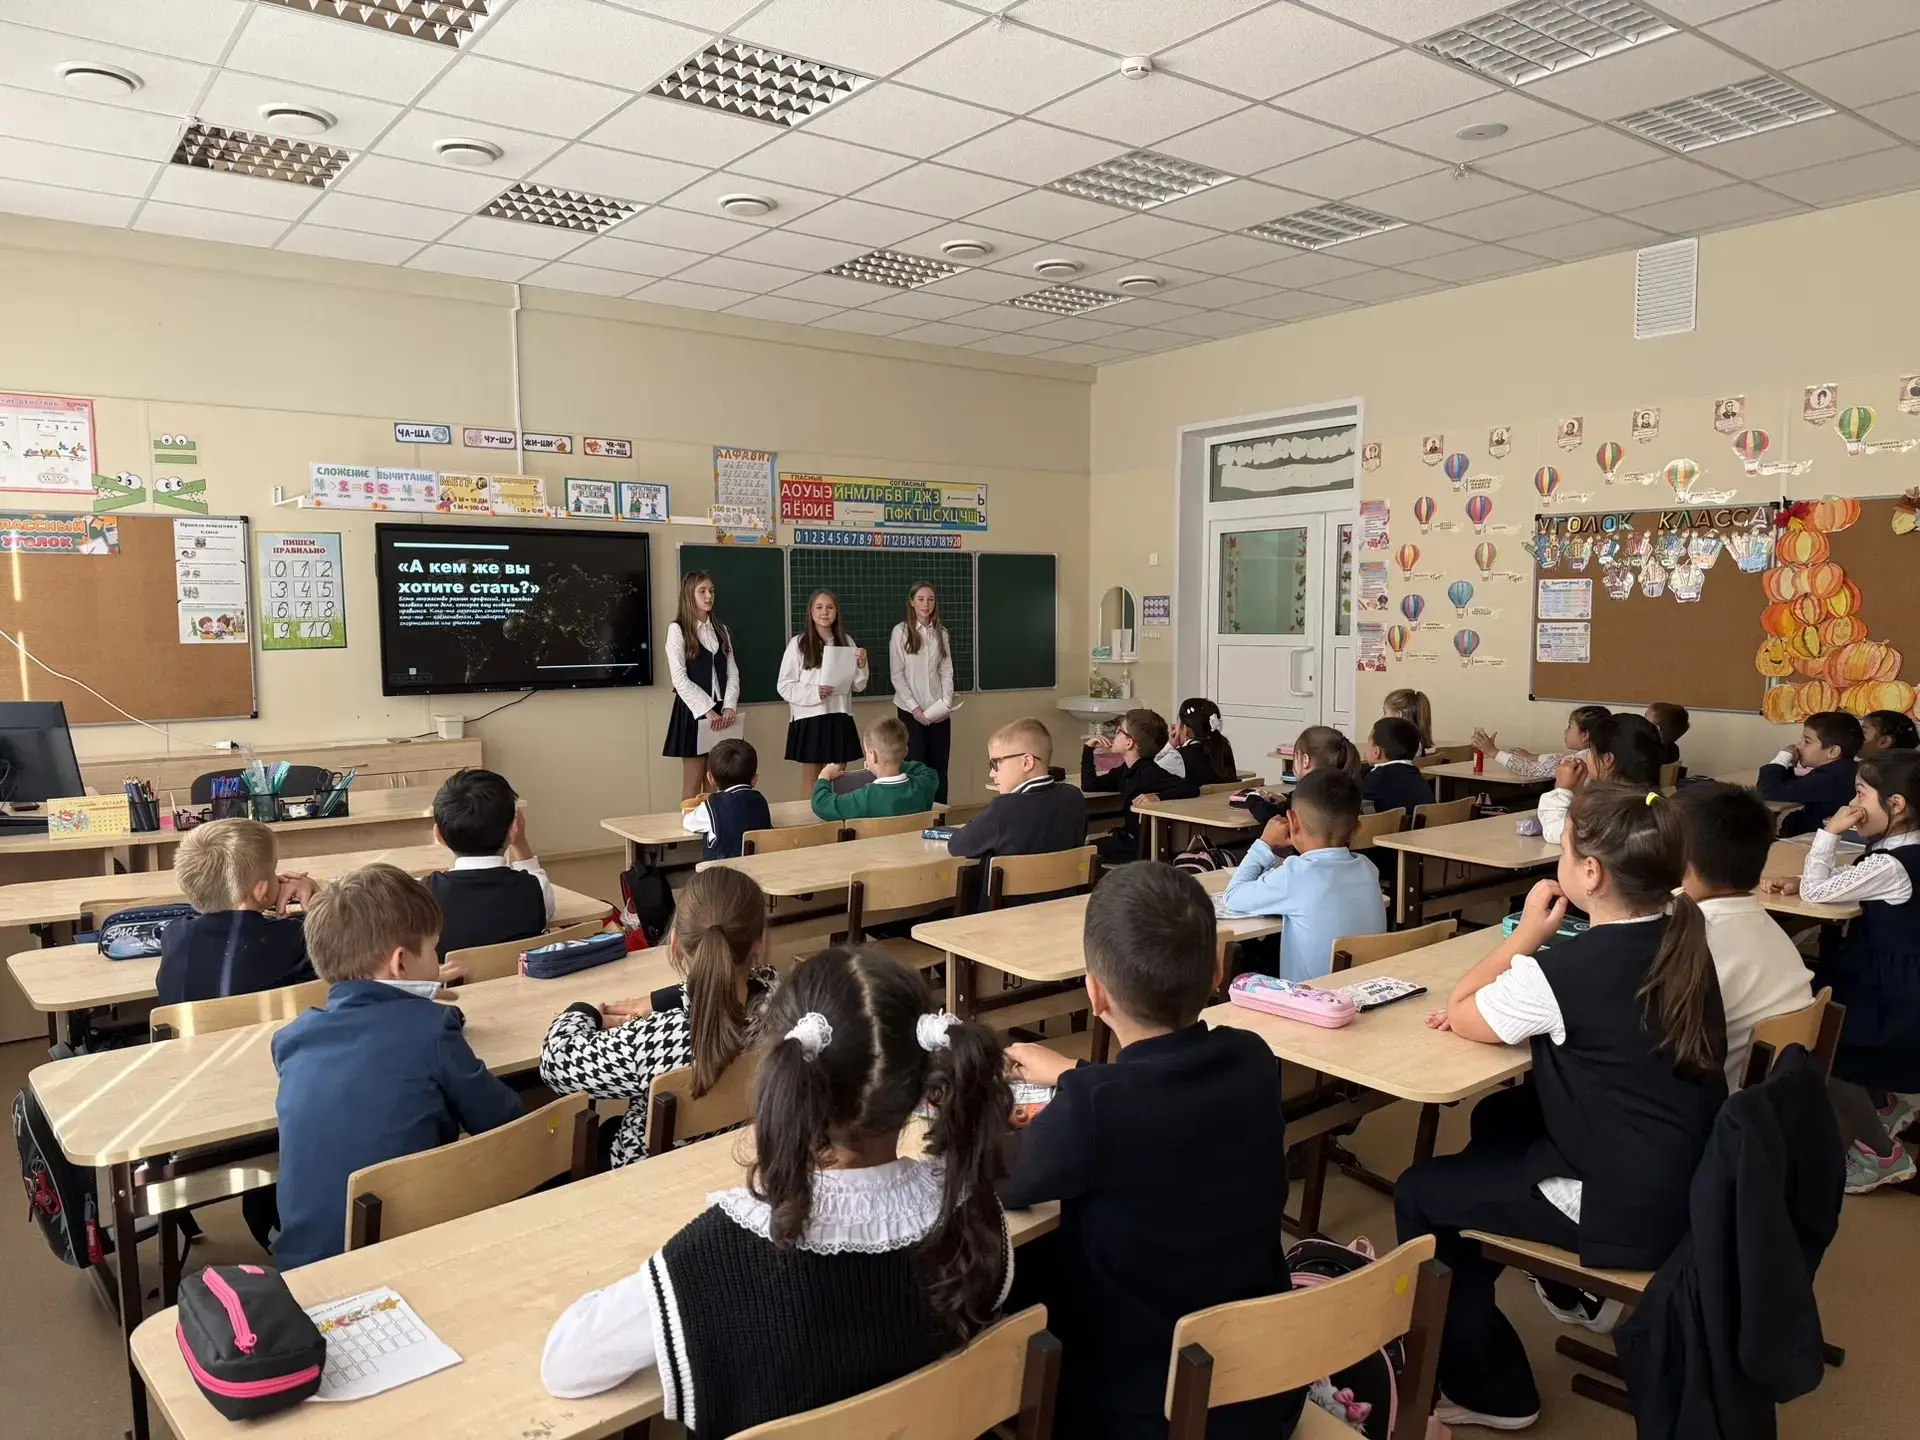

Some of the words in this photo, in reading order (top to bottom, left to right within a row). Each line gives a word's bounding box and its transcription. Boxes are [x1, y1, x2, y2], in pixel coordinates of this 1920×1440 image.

[398, 428, 430, 438] ЧА-ЩА
[484, 436, 513, 444] ЧУ-ЩУ
[525, 439, 553, 448] ЖИ-ШИ
[718, 449, 772, 462] АЛФАВИТ
[317, 467, 370, 478] СЛОЖЕНИЕ
[377, 471, 433, 482] ВЫЧИТАНИЕ
[339, 480, 349, 492] 2
[363, 482, 374, 493] 6
[378, 483, 389, 494] 6
[425, 486, 434, 497] 2
[1538, 513, 1634, 534] УГОЛОК
[1658, 506, 1769, 528] КЛАССА
[2, 536, 72, 548] УГОЛОК
[796, 531, 800, 542] 0
[804, 531, 808, 542] 1
[812, 532, 817, 543] 2
[820, 532, 825, 543] 3
[828, 532, 833, 543] 4
[836, 533, 840, 543] 5
[844, 533, 848, 544] 6
[852, 534, 856, 544] 7
[860, 534, 864, 544] 8
[867, 534, 872, 545] 9
[874, 534, 881, 545] 10
[884, 535, 889, 545] 11
[892, 535, 898, 546] 12
[900, 536, 906, 546] 13
[908, 536, 915, 546] 14
[916, 536, 922, 546] 15
[923, 536, 930, 546] 16
[931, 536, 938, 547] 17
[939, 536, 945, 547] 18
[947, 536, 953, 547] 19
[953, 536, 960, 547] 20
[275, 560, 286, 577] 0
[302, 560, 309, 577] 1
[321, 560, 332, 577] 2
[398, 559, 424, 573] «А
[430, 563, 466, 573] кем
[472, 563, 499, 574] же
[505, 564, 530, 574] вы
[276, 581, 287, 598] 3
[302, 581, 310, 598] 4
[321, 581, 333, 597] 5
[398, 583, 464, 593] хотите
[470, 580, 540, 594] стать?»
[278, 602, 289, 618] 6
[300, 601, 311, 618] 7
[324, 601, 335, 617] 8
[279, 622, 289, 638] 9
[308, 621, 332, 638] 10
[107, 925, 140, 939] SPACE
